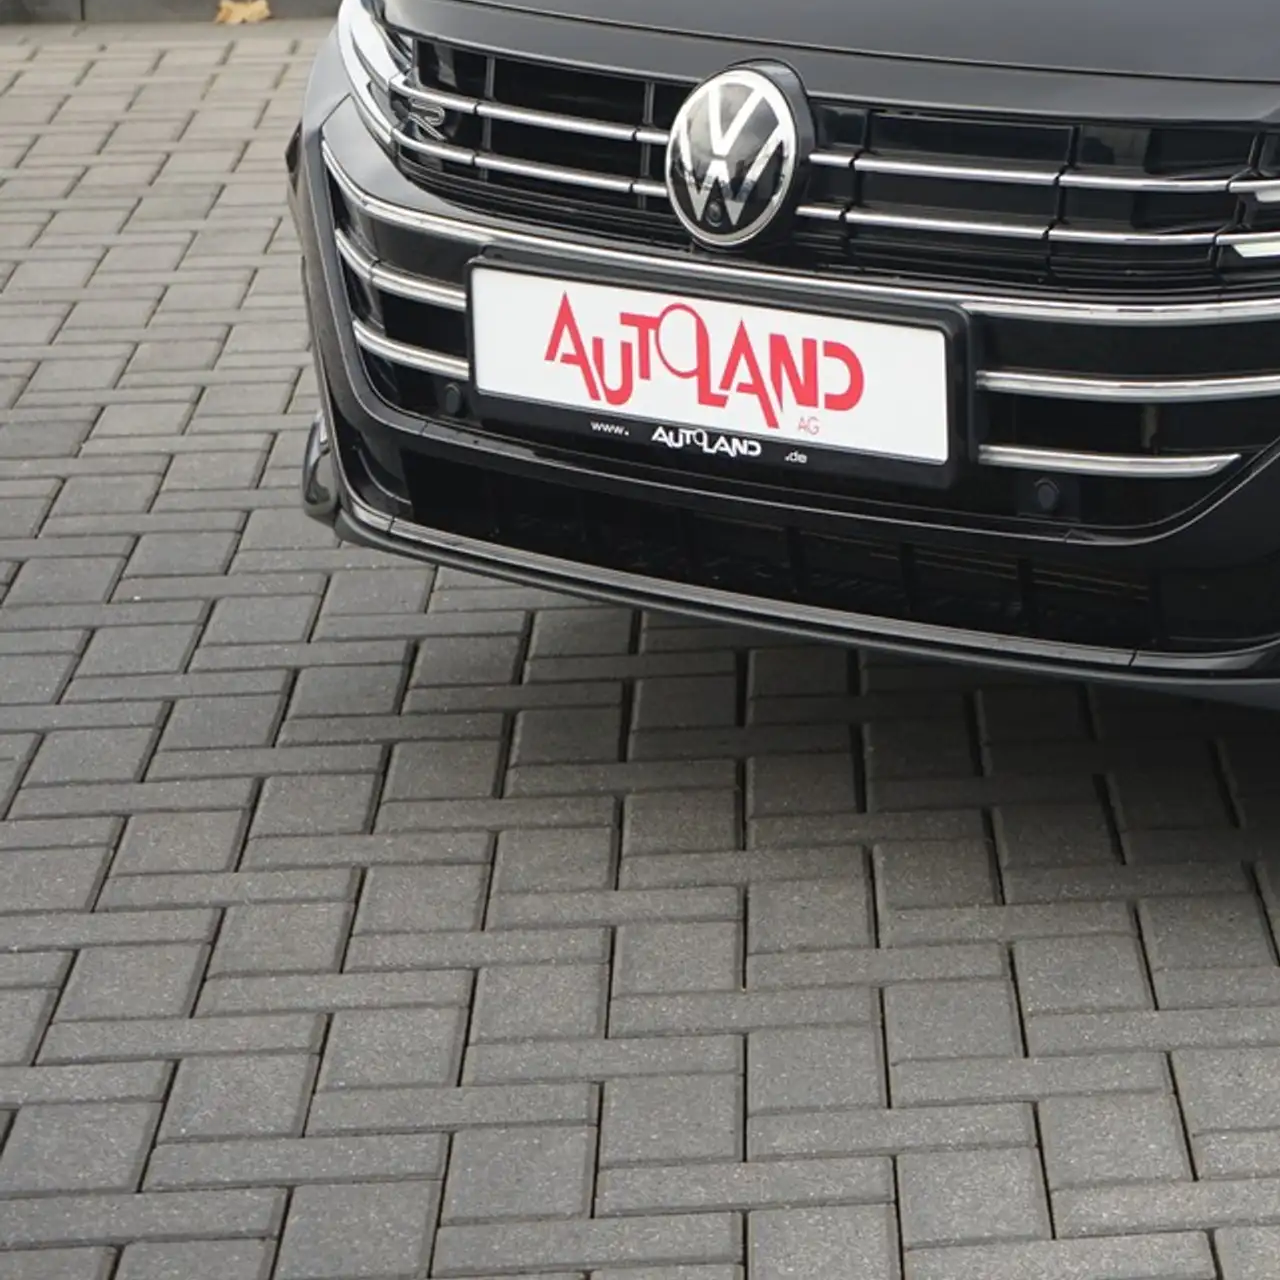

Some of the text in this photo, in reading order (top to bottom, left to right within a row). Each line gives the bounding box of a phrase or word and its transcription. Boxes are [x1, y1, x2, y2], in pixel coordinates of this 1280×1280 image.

[544, 290, 865, 429] AUTOLAND
[590, 421, 808, 464] www. AUTOLAND .de
[798, 416, 821, 435] AG
